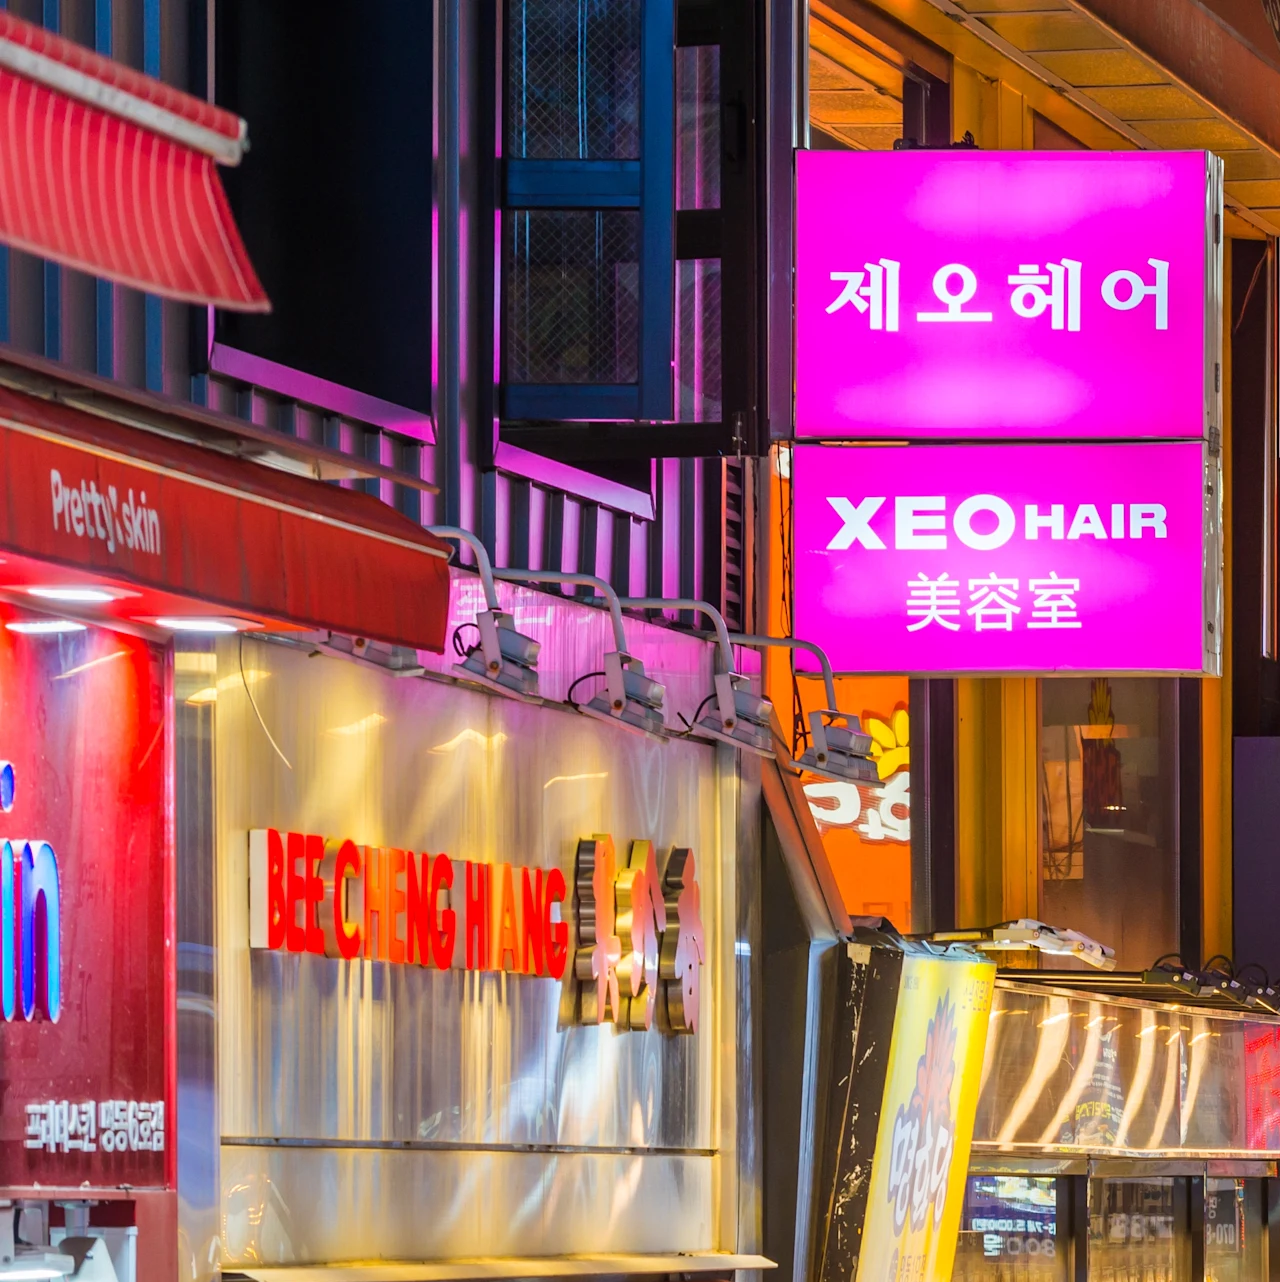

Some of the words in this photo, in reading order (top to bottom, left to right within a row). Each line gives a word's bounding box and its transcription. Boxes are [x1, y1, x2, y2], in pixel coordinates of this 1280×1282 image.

[825, 257, 1170, 332] 제오헤어
[825, 494, 1016, 551] XEO
[1024, 502, 1167, 540] HAIR
[905, 571, 1083, 633] 美容室
[267, 829, 328, 956] BEE
[333, 838, 455, 972] CHENG
[465, 857, 569, 980] HIANG
